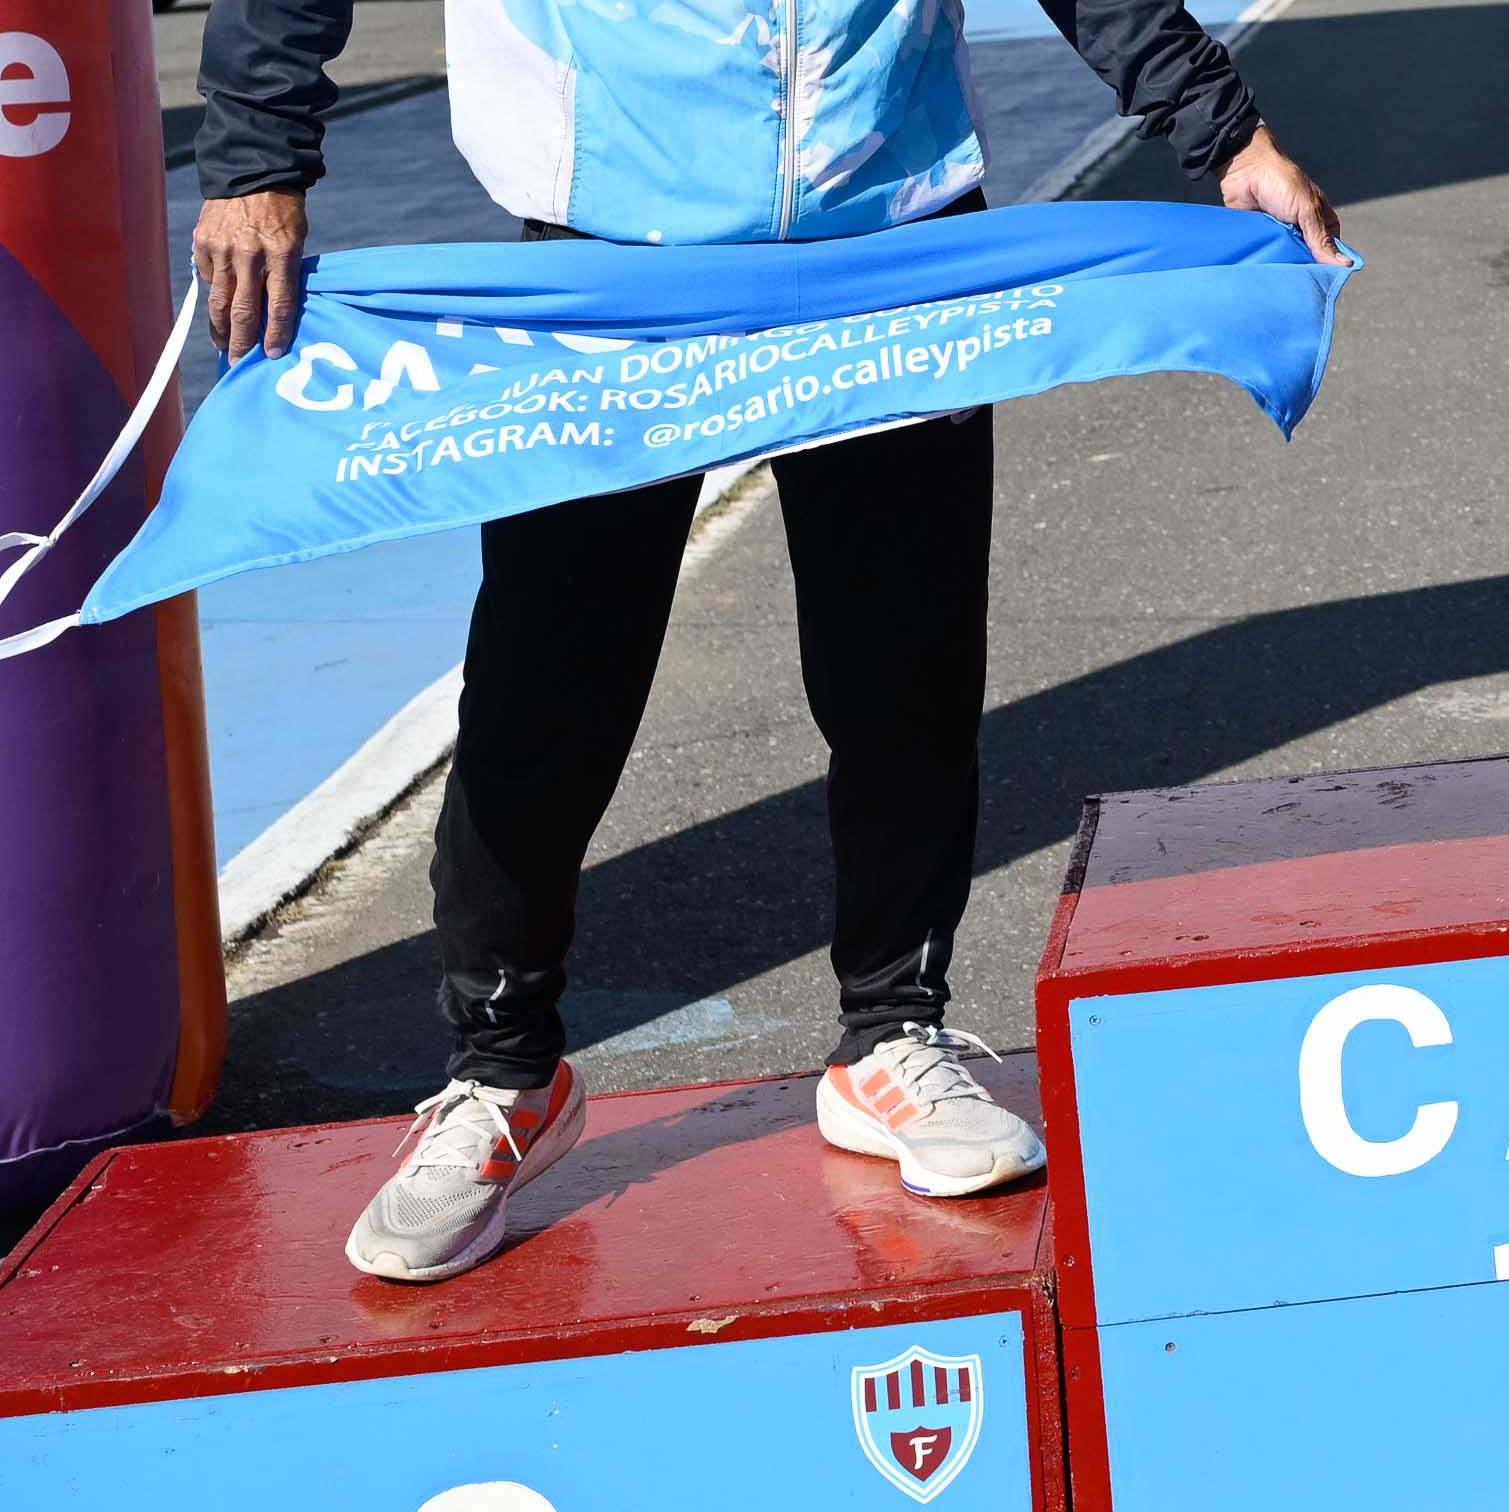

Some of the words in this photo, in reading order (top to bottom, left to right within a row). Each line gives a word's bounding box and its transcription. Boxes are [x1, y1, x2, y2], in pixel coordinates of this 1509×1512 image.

[335, 421, 616, 483] INSTAGRAM:
[642, 314, 1054, 449] @rosario.calleypista
[600, 299, 1057, 411] ROSARIOCALLEYPISTA
